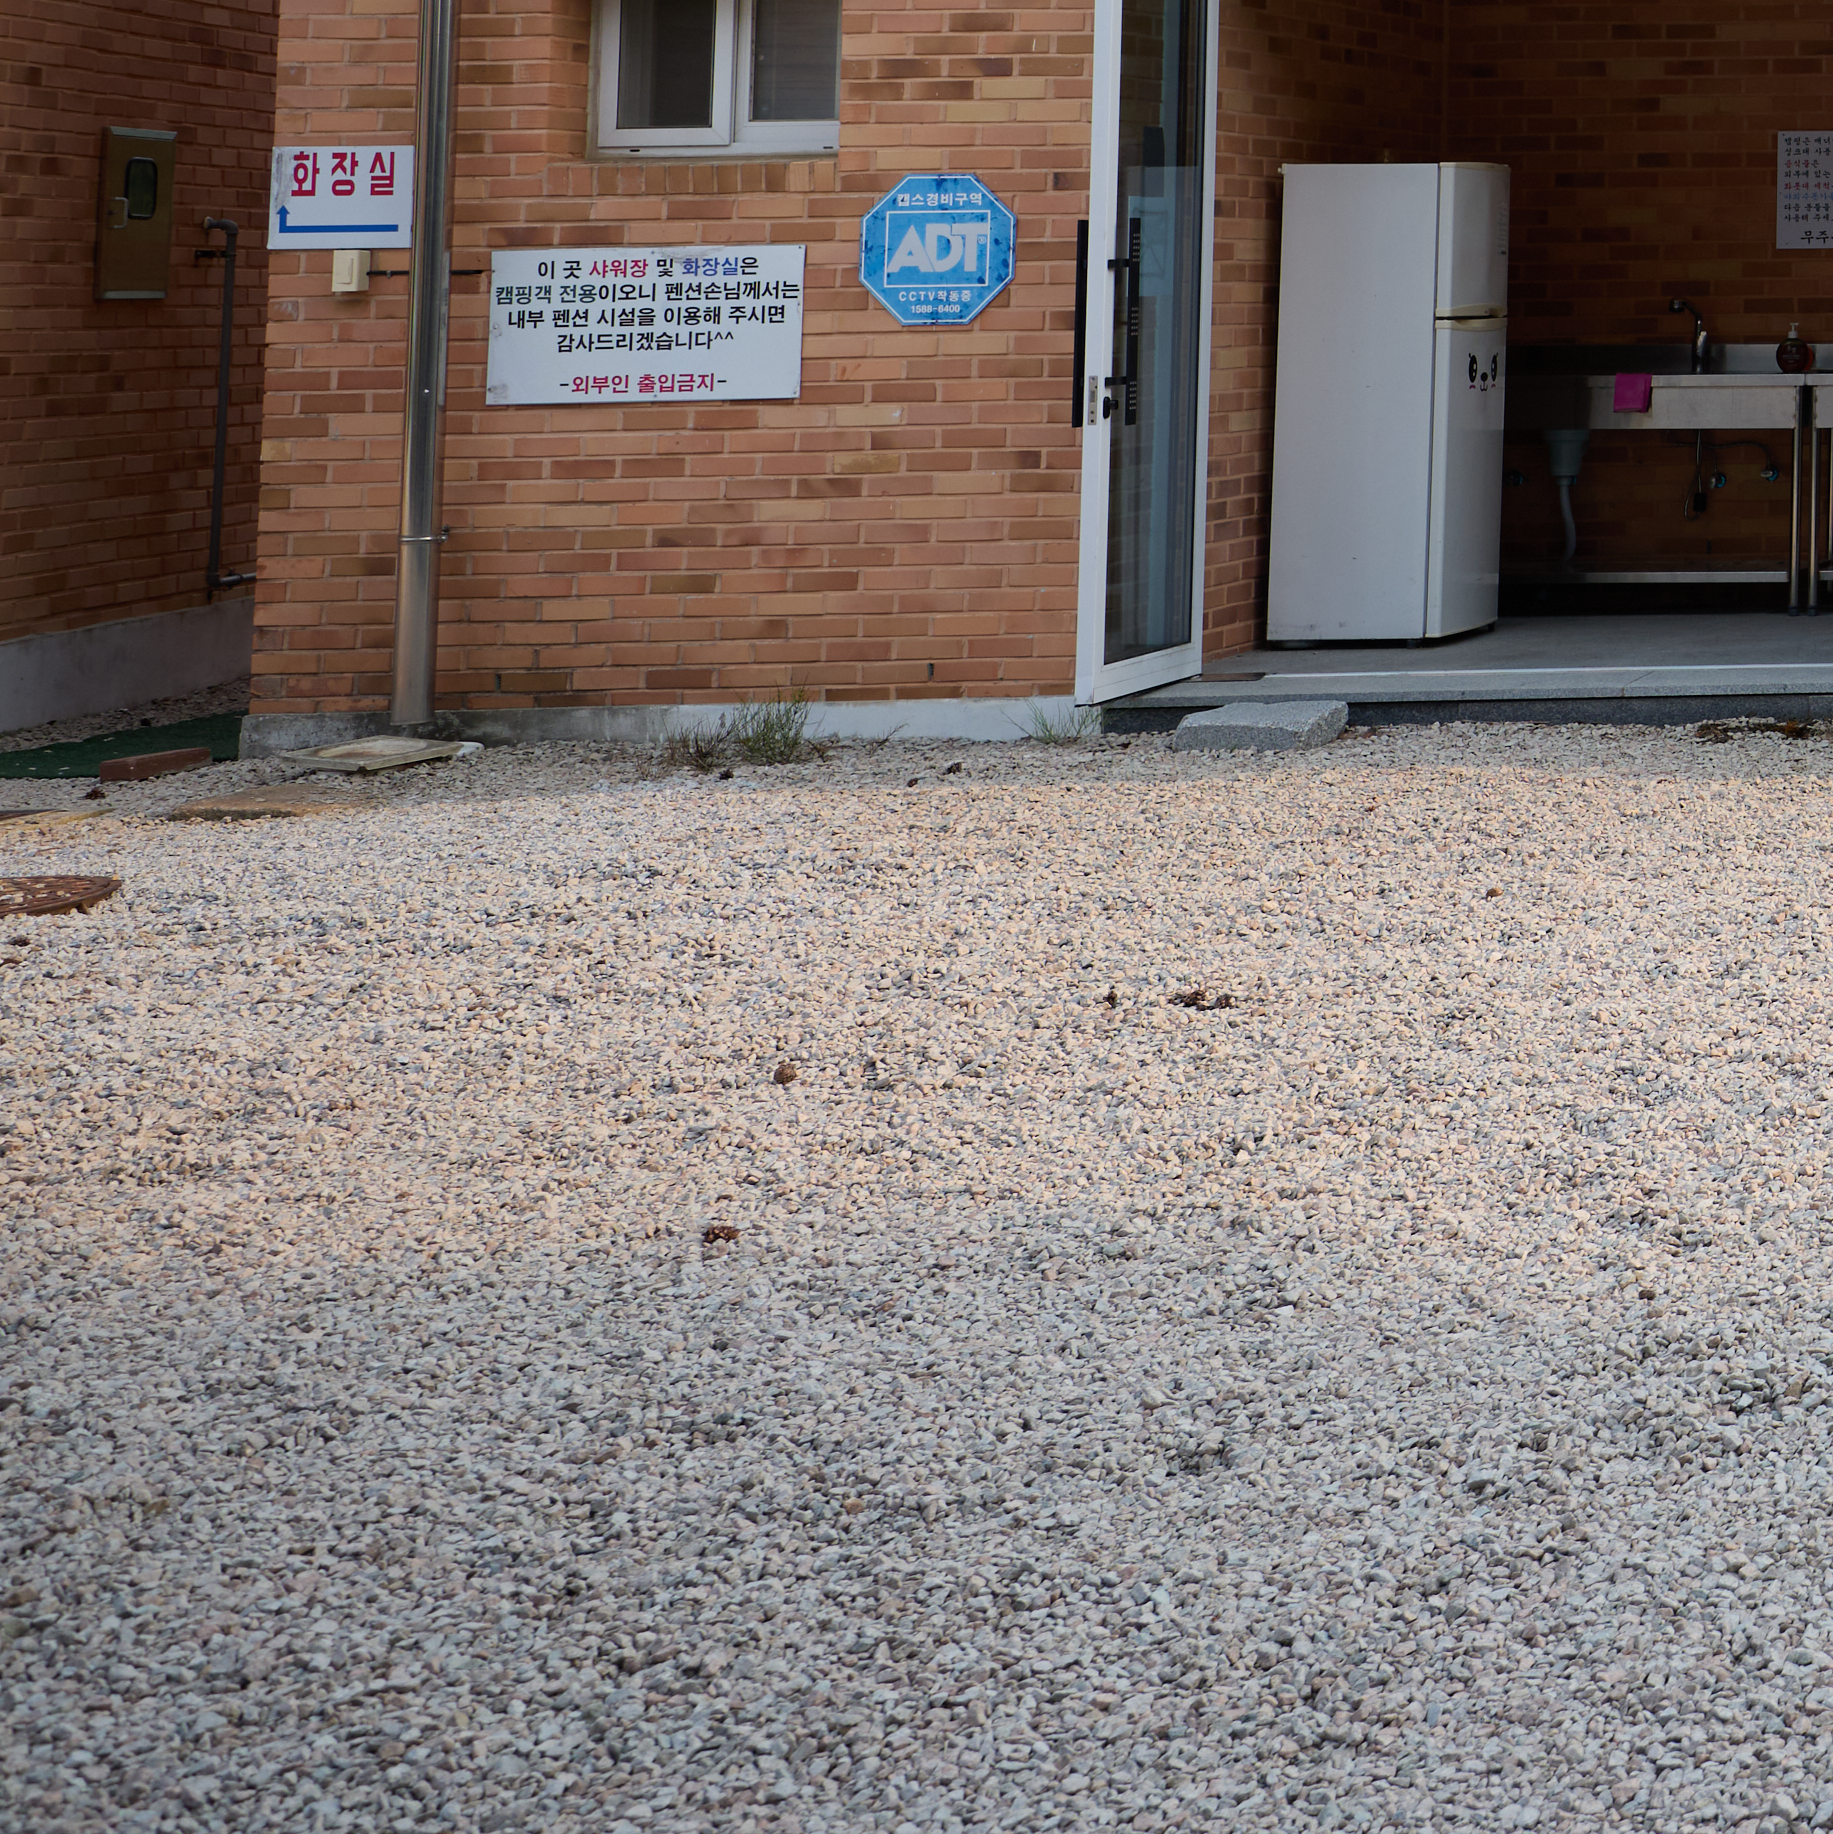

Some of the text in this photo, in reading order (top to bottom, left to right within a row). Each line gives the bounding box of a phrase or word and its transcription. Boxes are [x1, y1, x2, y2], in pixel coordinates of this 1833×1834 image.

[1785, 137, 1811, 146] 캠핑은
[1785, 147, 1810, 156] 싱크대
[1815, 147, 1831, 156] 사용
[1785, 159, 1820, 168] 음식물은
[291, 151, 395, 196] 화장실
[1784, 170, 1809, 178] 외부에
[1814, 169, 1831, 178] 있는
[897, 193, 982, 207] 캡스경비구역
[1784, 203, 1801, 212] 다음
[1784, 213, 1809, 222] 사용해
[887, 222, 990, 273] ADT
[538, 256, 759, 280] 이 곳 샤워장 및 화장실은
[495, 280, 801, 305] 캠핑객 전용이오니 펜션손님께서는
[898, 290, 971, 302] CCTV작동중
[911, 304, 960, 313] 1588-6400
[508, 304, 785, 329] 내부 펜션 시설을 이용해 주시면
[557, 330, 734, 352] 감사드리겠습니다^^
[559, 372, 727, 395] -외부인 출입금지-
